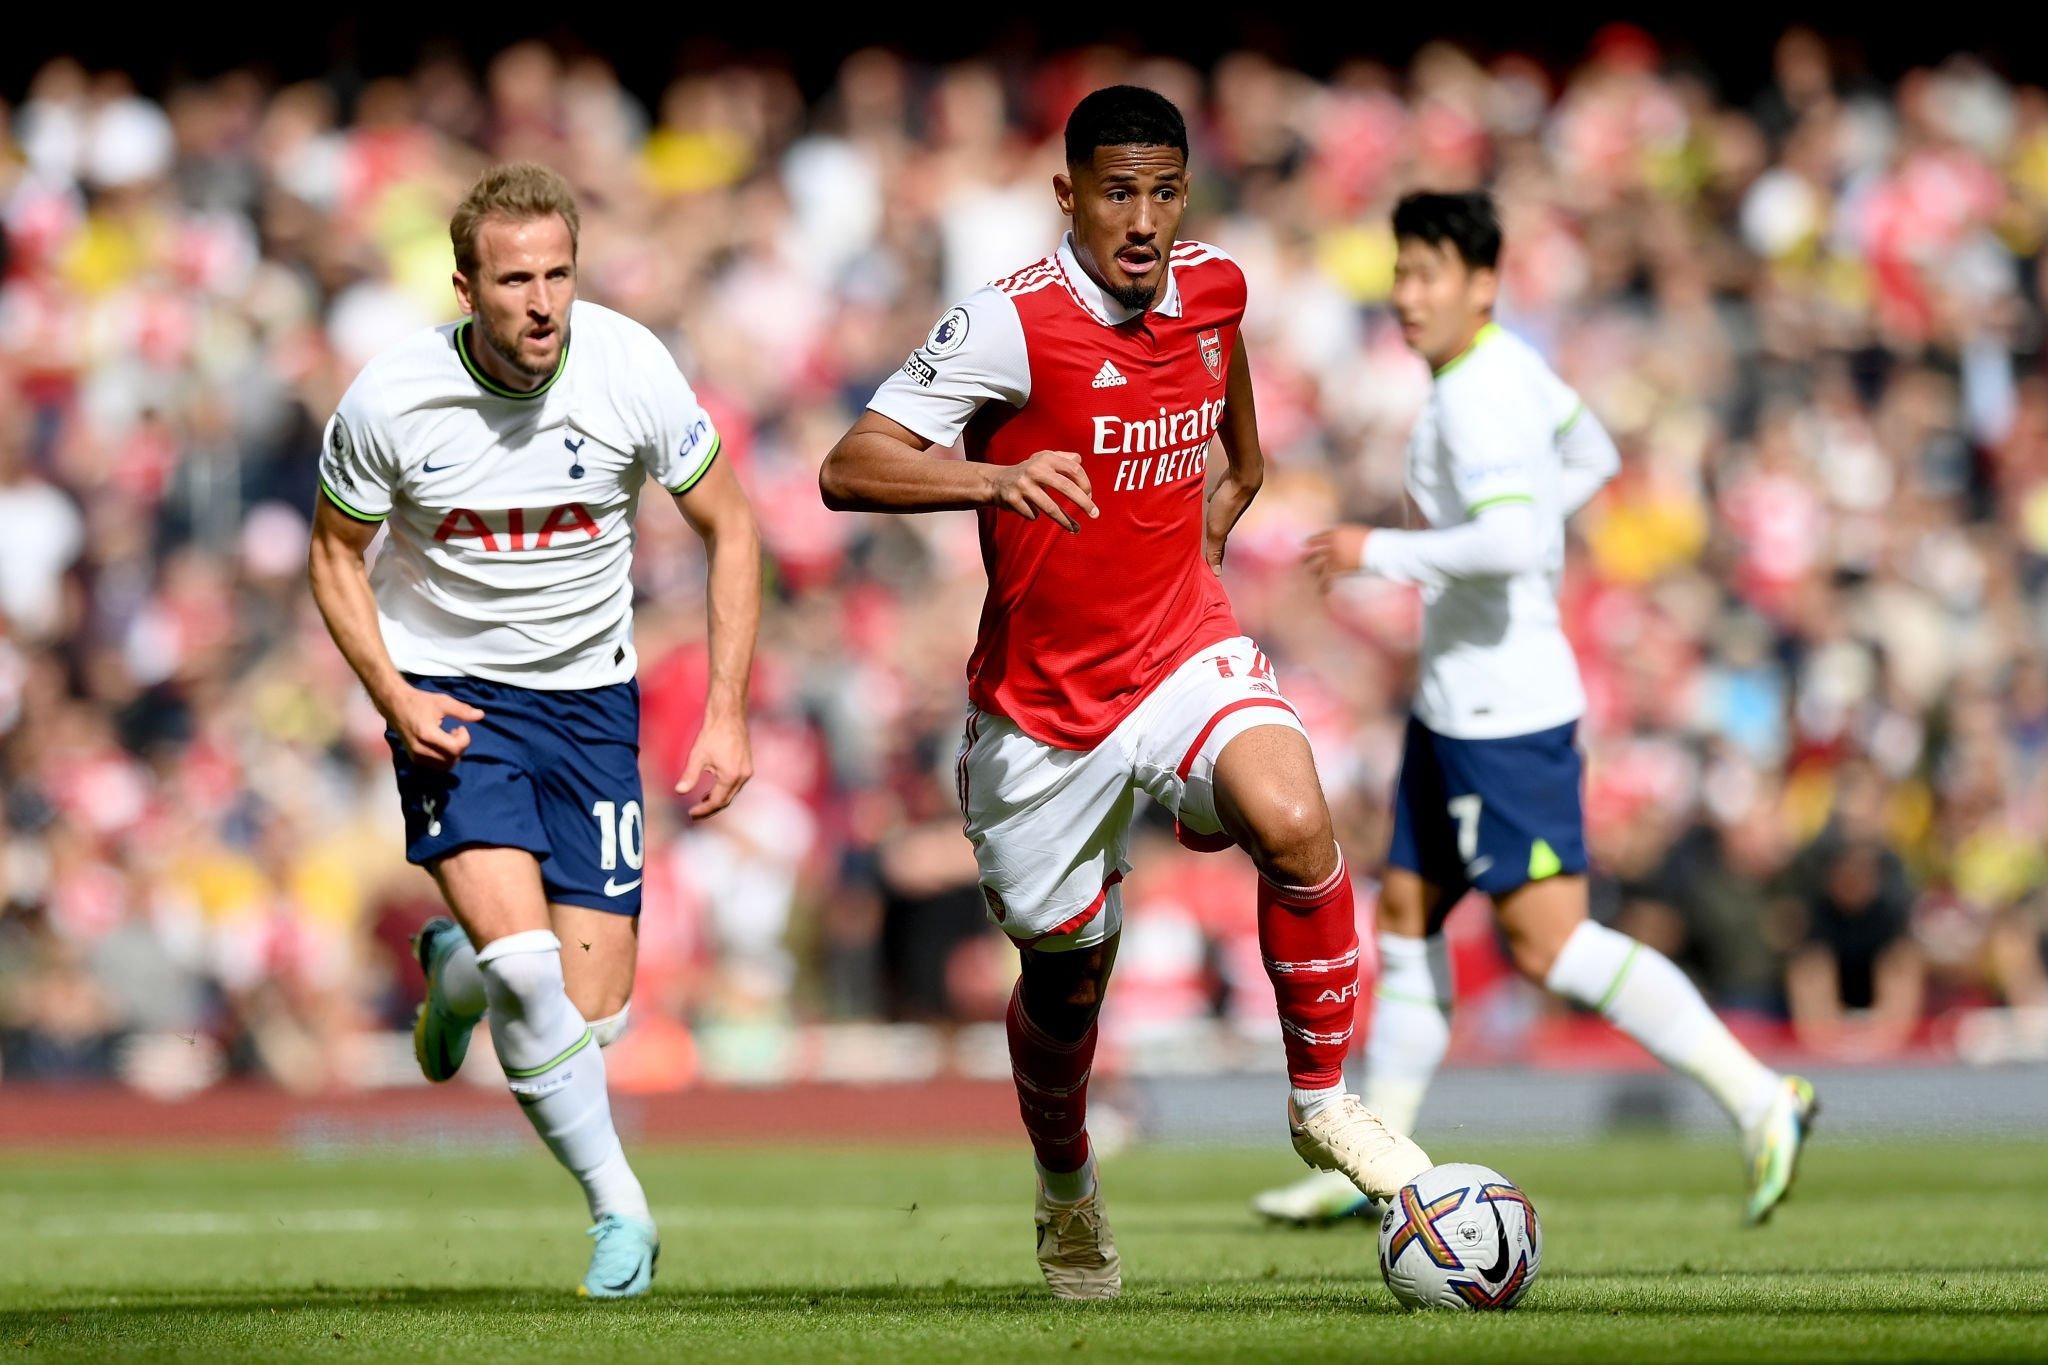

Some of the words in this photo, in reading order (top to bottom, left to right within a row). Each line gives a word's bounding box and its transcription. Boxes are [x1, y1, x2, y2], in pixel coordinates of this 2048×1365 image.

[1091, 375, 1128, 389] adidas
[679, 419, 707, 457] cin
[1113, 457, 1153, 492] FLY
[433, 502, 601, 553] AIA
[592, 799, 644, 871] 10
